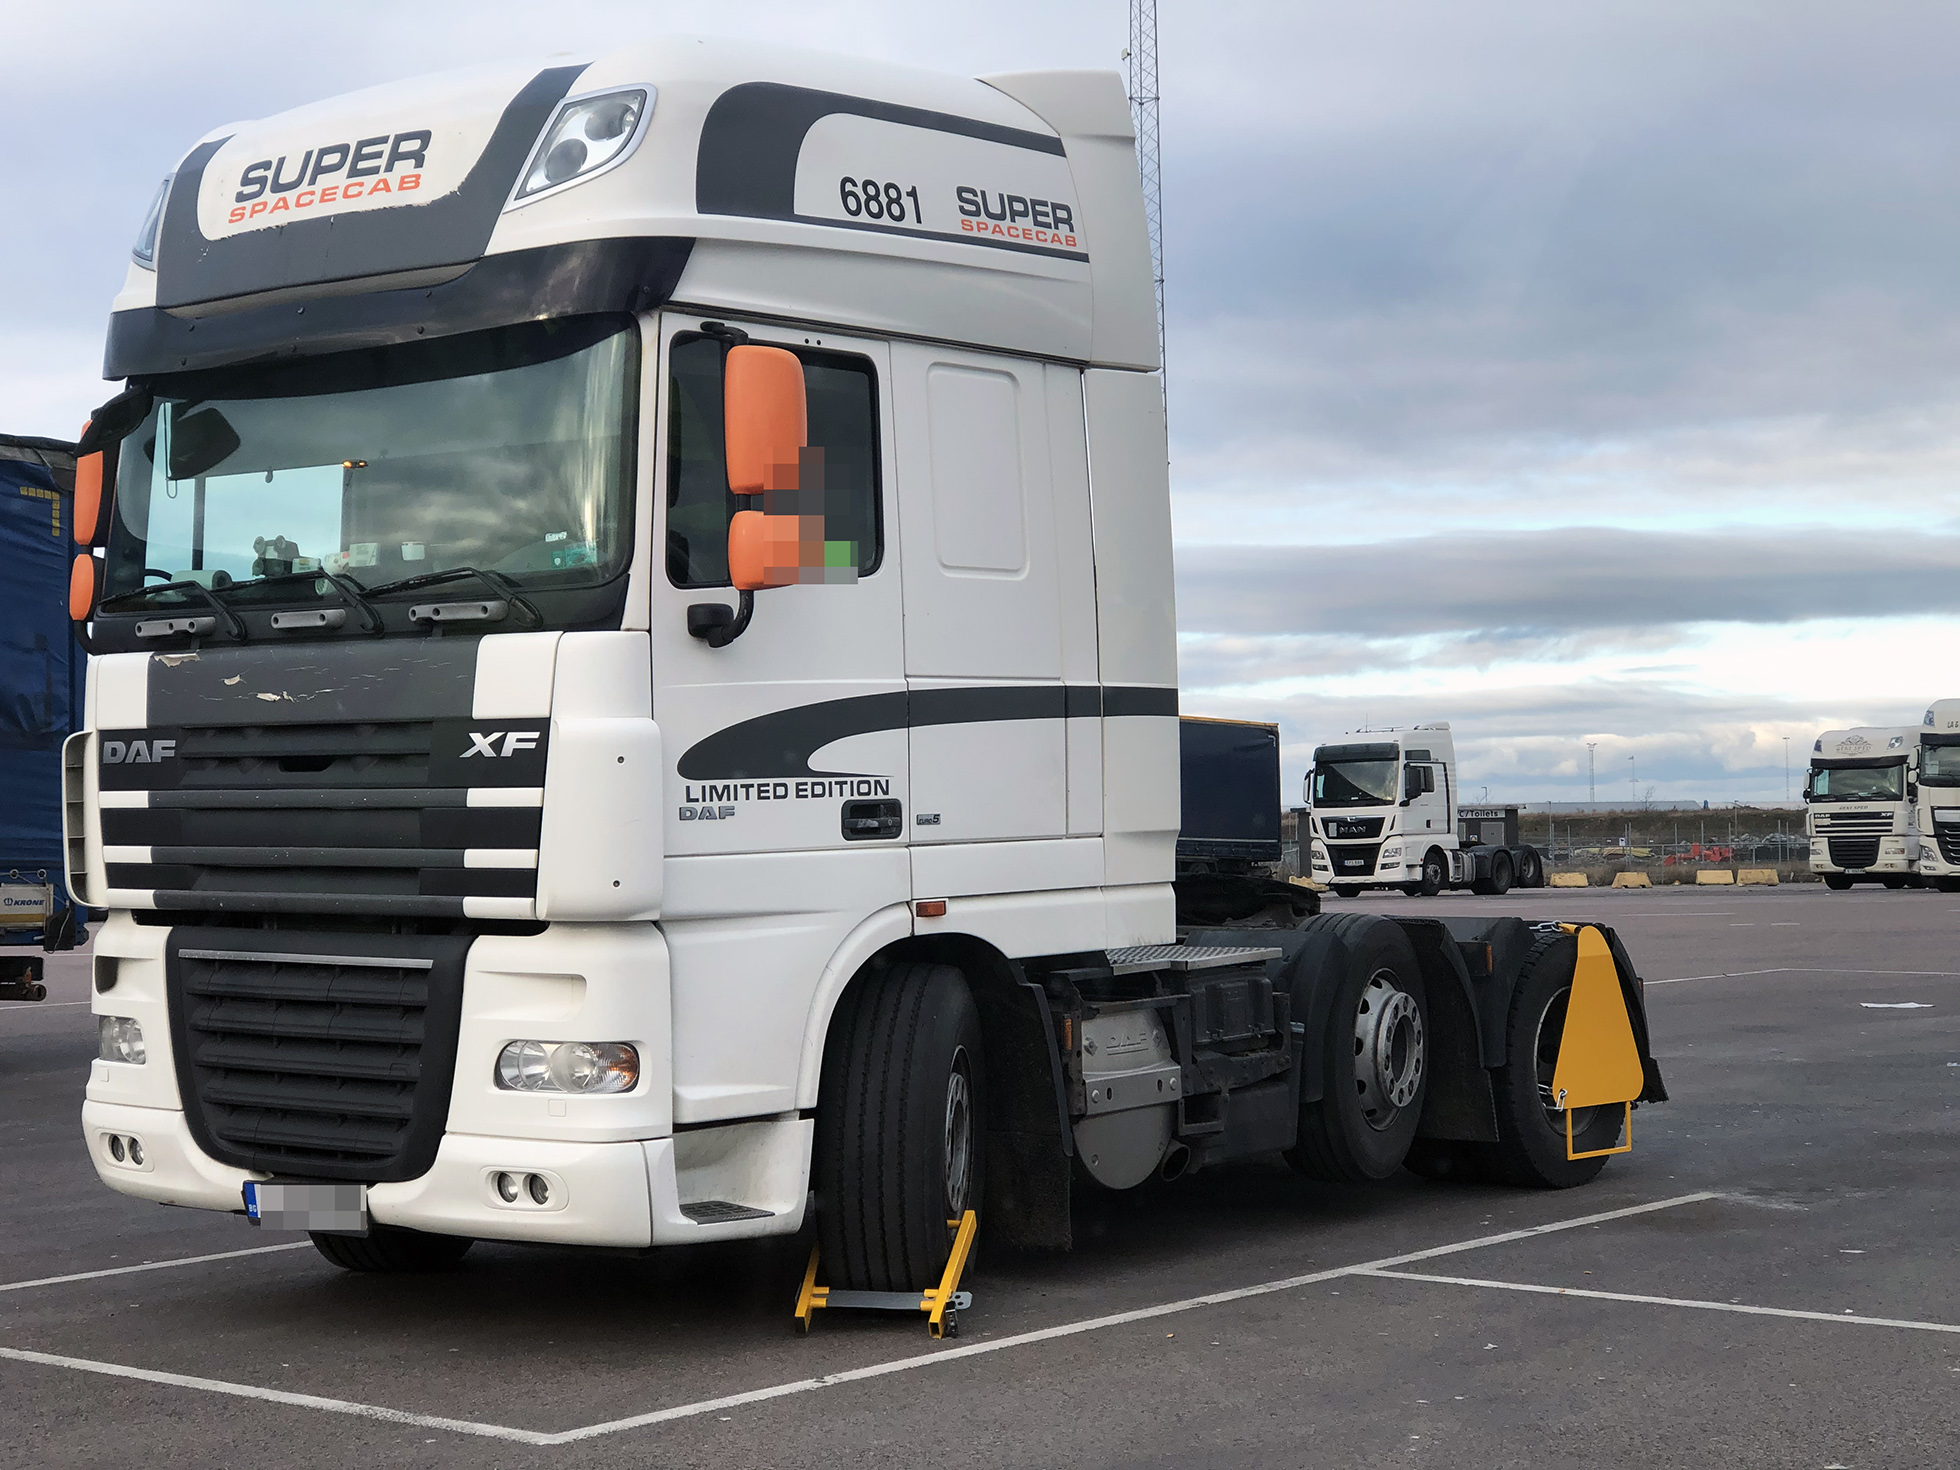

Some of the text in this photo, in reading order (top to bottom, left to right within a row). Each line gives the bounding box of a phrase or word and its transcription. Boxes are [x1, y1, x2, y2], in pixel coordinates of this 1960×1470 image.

[235, 129, 432, 203] SUPER
[228, 173, 422, 224] SPACECAB
[840, 176, 922, 224] 6881
[956, 185, 1075, 233] SUPER
[960, 218, 1078, 247] SPACECAB
[103, 739, 176, 764] DAF
[459, 731, 541, 758] XF
[685, 779, 890, 803] LIMITED EDITION
[679, 805, 735, 821] DAF
[248, 1203, 258, 1213] BG
